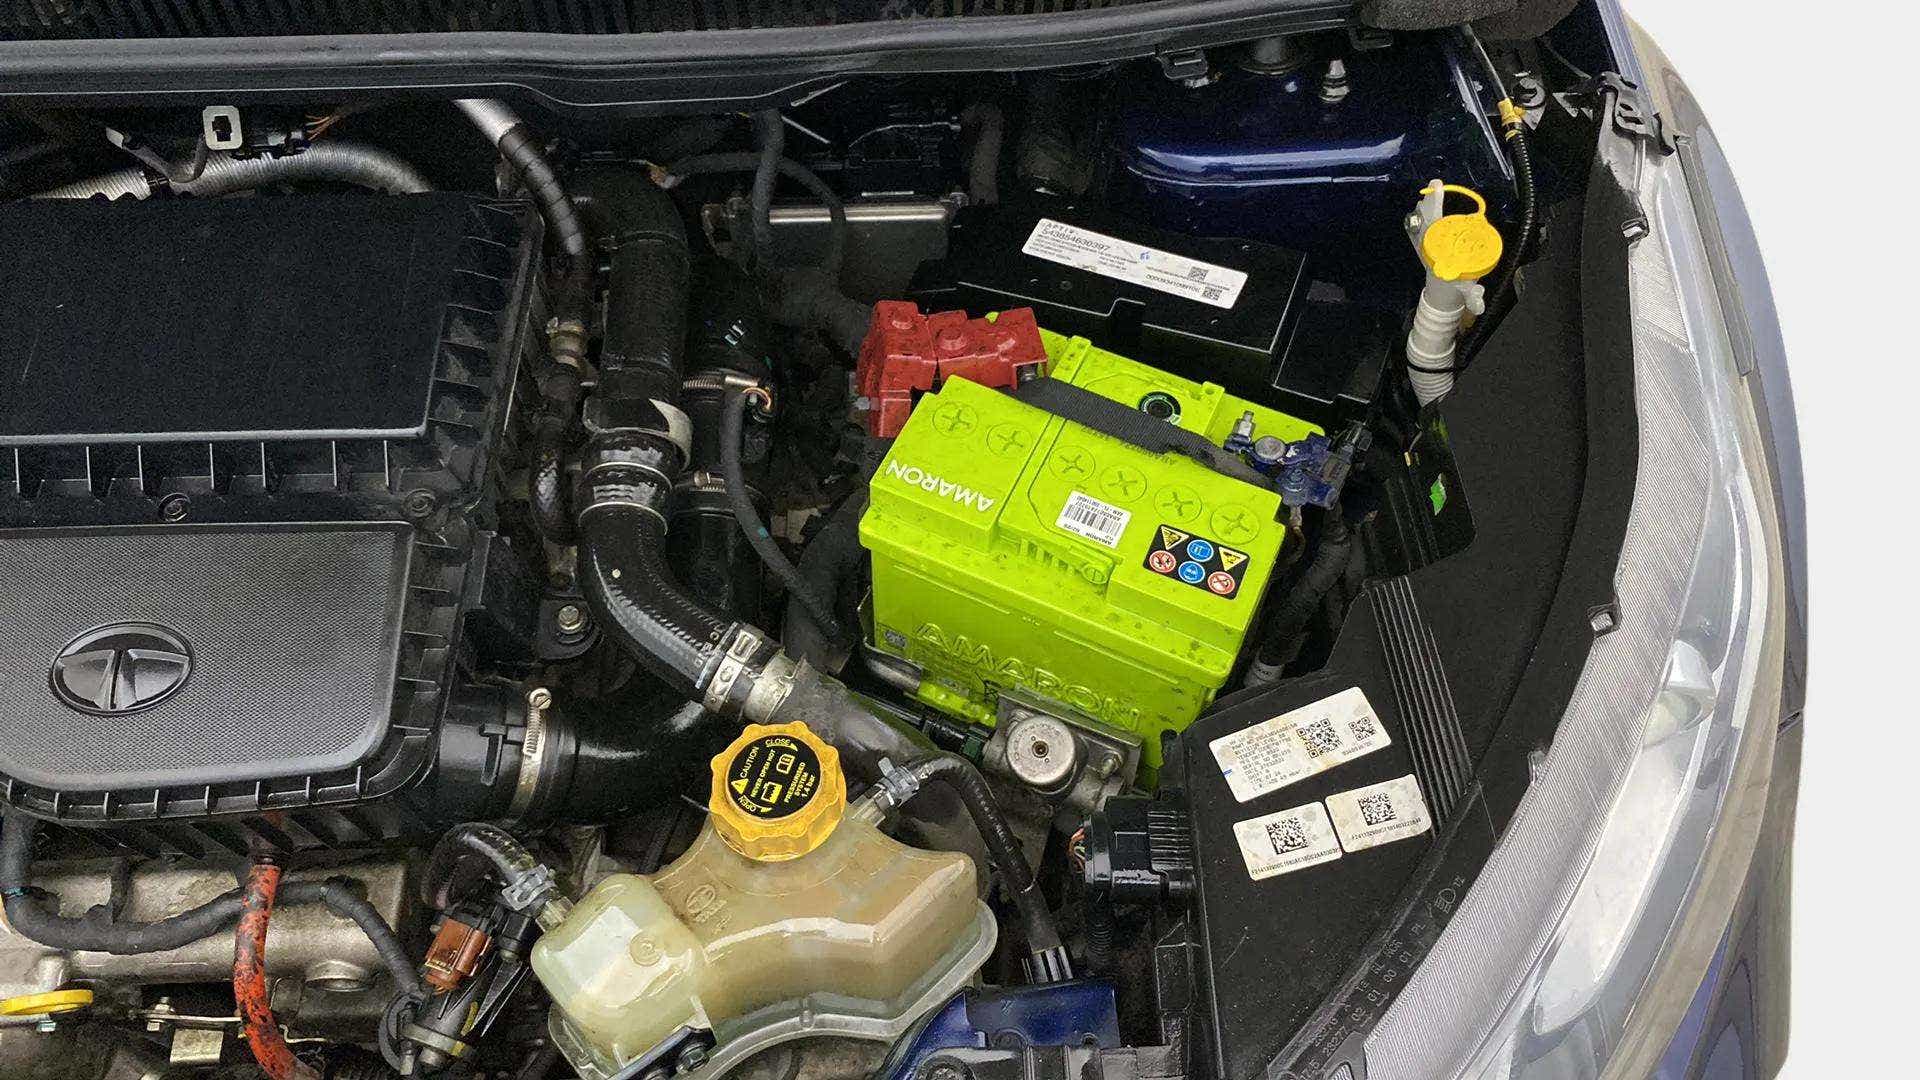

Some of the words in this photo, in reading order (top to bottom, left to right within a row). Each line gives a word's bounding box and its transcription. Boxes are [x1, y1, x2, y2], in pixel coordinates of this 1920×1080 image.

[886, 459, 995, 512] AMARON
[765, 738, 791, 746] CLOSE
[740, 746, 760, 778] CAUTION
[760, 761, 771, 778] OPEN
[738, 795, 757, 812] OPEN
